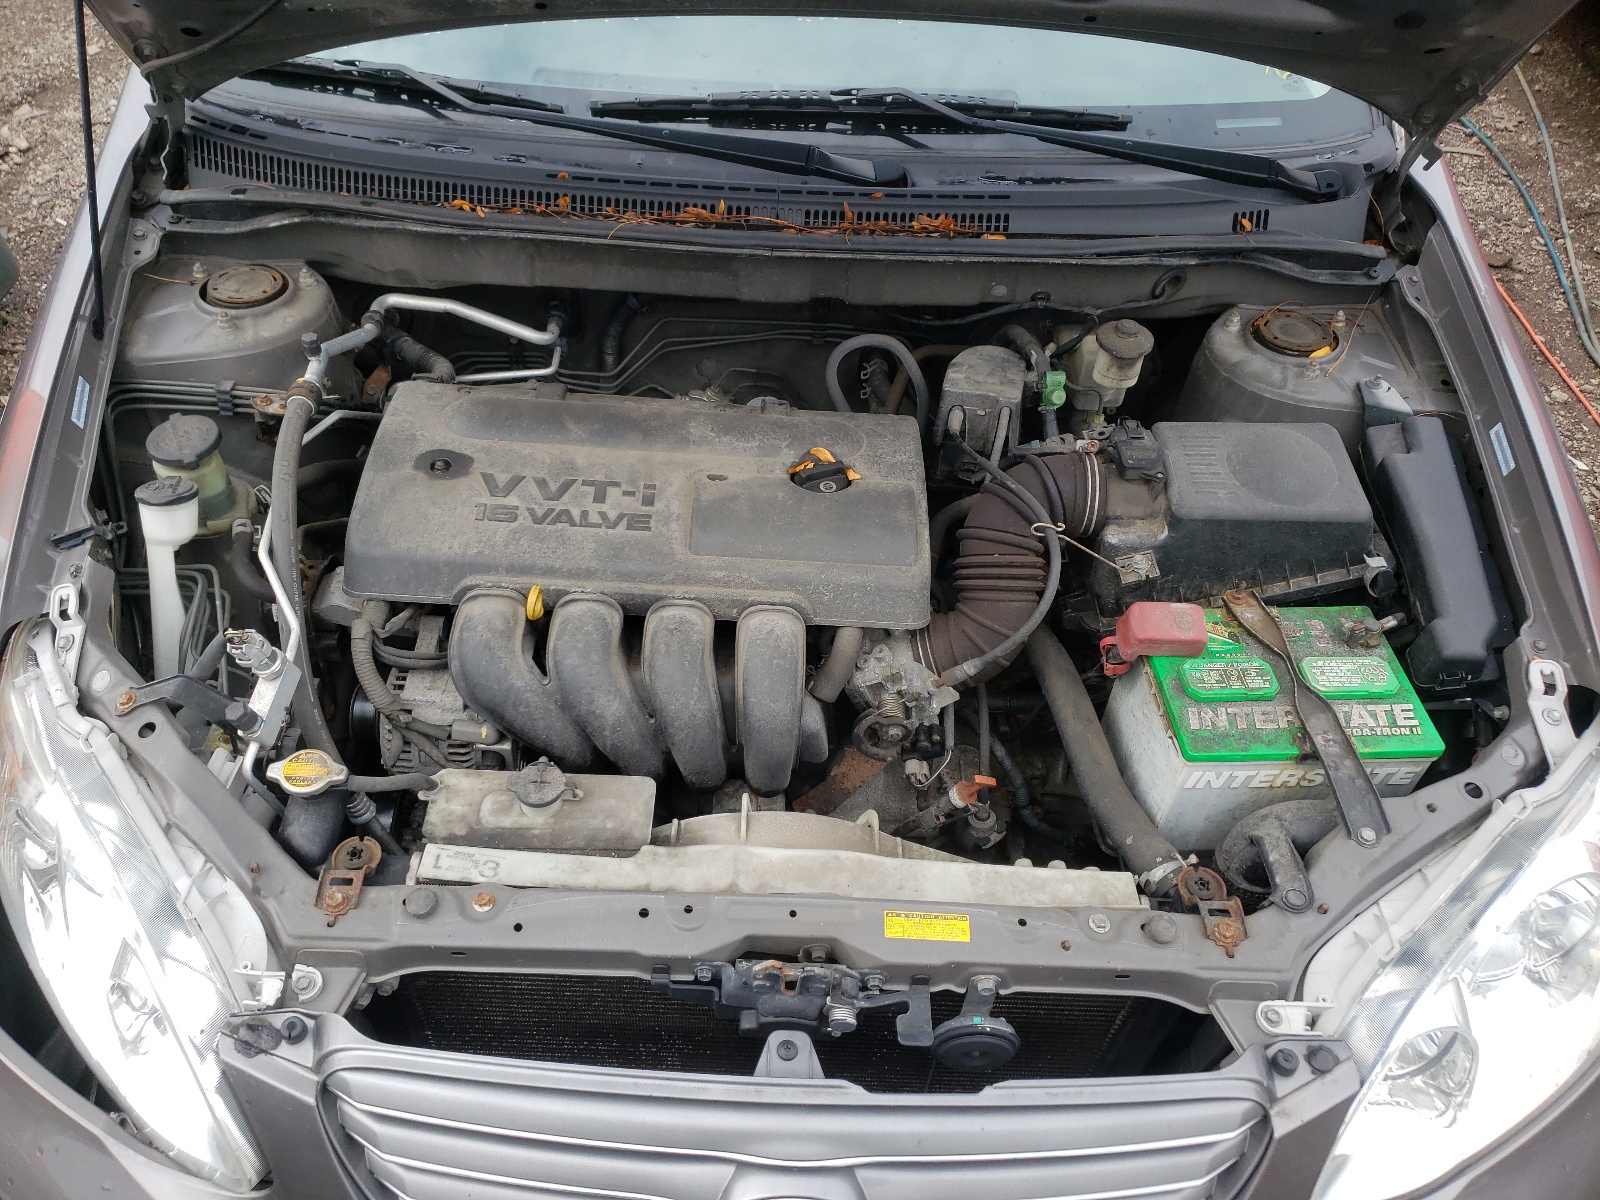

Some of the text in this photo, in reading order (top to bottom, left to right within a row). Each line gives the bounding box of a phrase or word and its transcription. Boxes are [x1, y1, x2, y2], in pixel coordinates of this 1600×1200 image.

[480, 472, 657, 507] VVT-i
[474, 503, 653, 532] 16 VALVE
[1188, 704, 1419, 730] INTERTATE
[1344, 727, 1410, 737] EGA-TRON
[1183, 768, 1422, 789] INTERSTE
